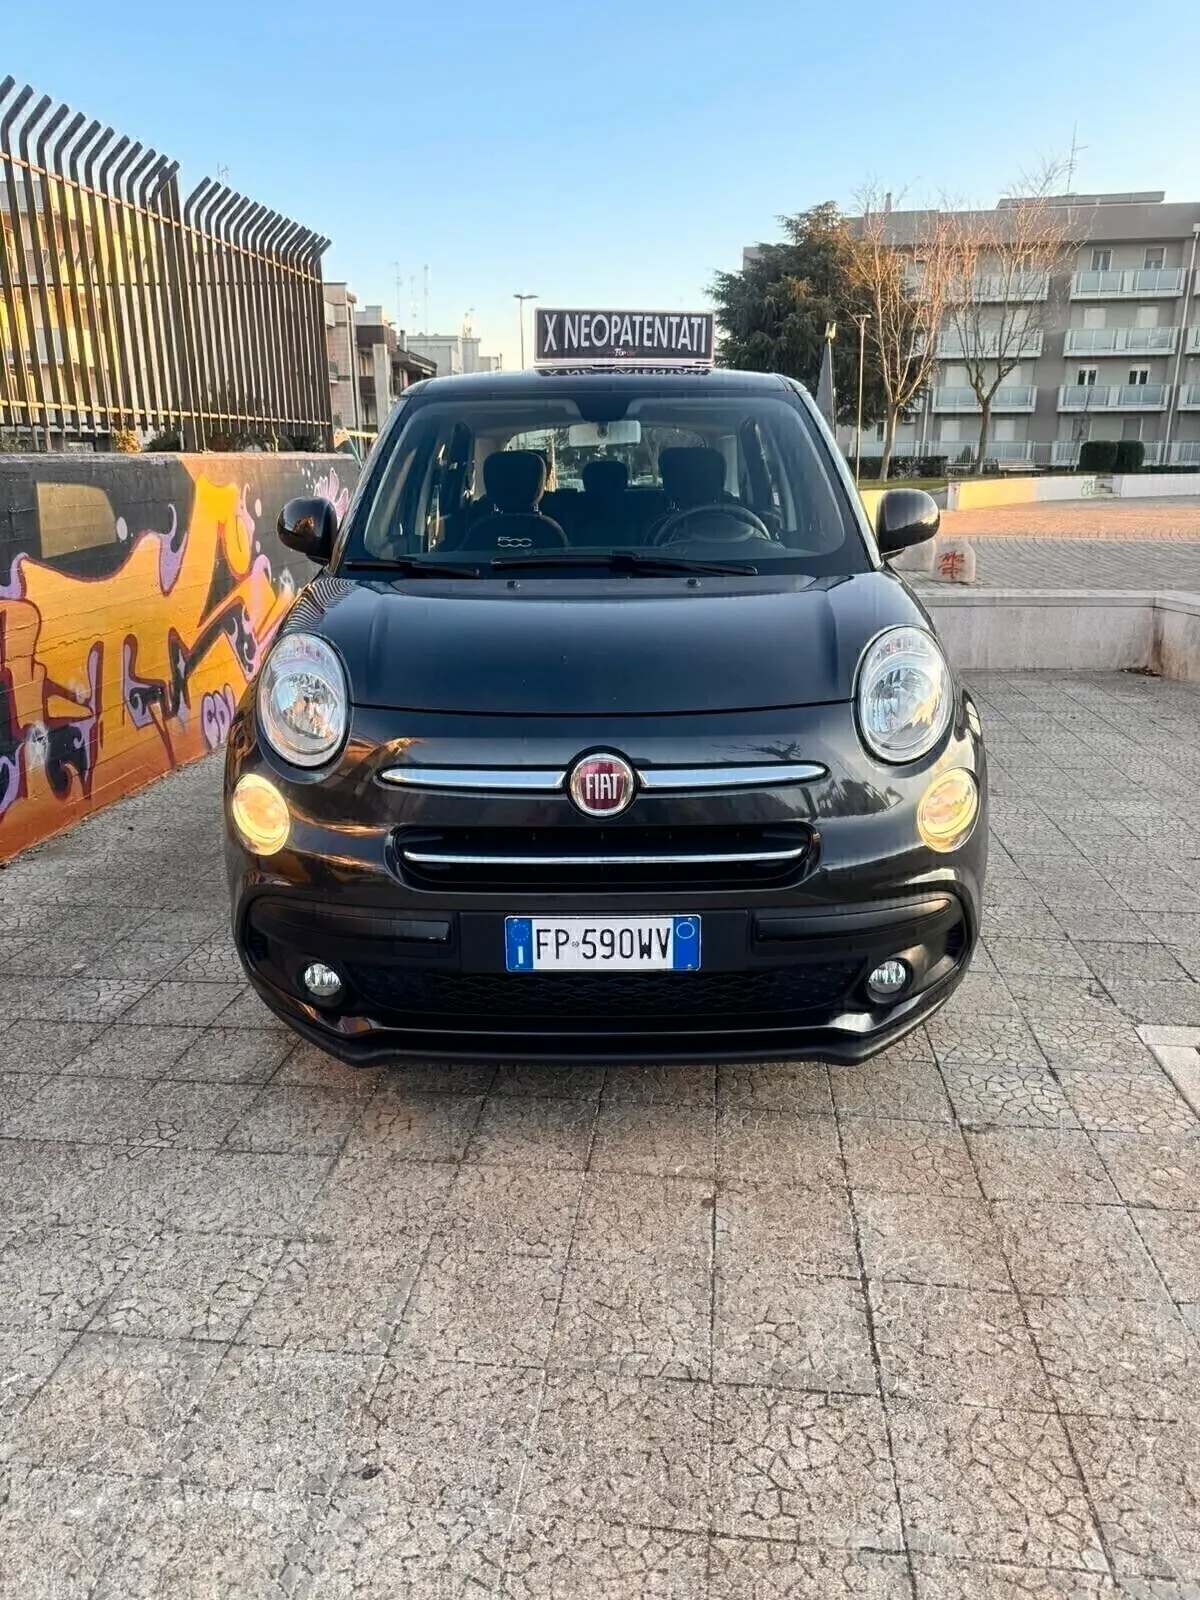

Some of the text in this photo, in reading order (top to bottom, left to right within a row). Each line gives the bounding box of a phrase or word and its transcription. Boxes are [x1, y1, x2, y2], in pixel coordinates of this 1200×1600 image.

[543, 313, 707, 353] X NEOPATENTATI
[585, 773, 620, 800] FIAT
